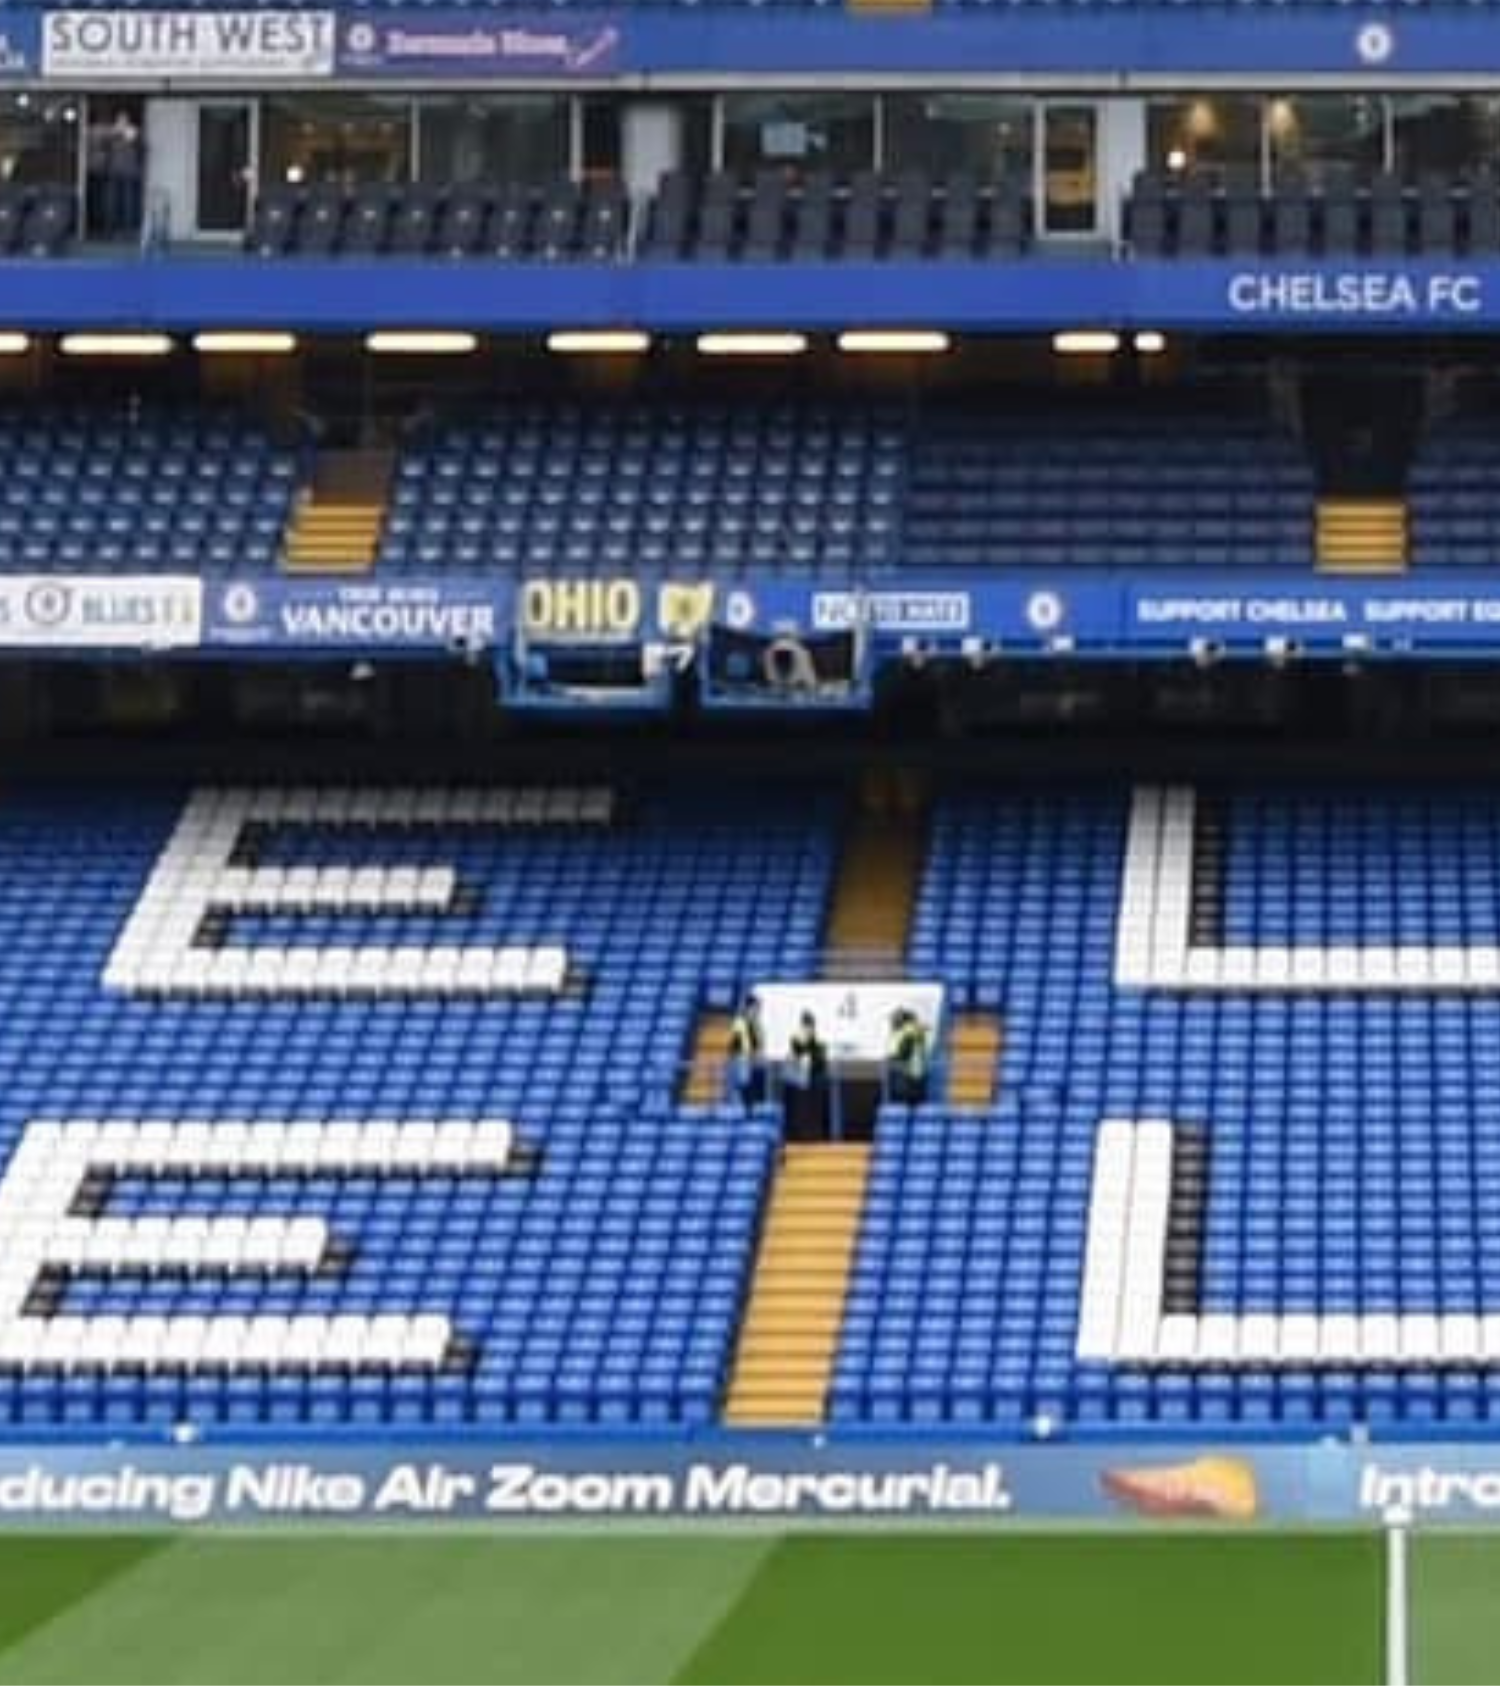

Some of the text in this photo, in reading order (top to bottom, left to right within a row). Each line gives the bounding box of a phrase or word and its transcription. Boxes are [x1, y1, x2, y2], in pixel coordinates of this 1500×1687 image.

[51, 15, 325, 53] SOUTH WEST
[1226, 272, 1482, 312] CHELSEA FC
[281, 604, 495, 636] VANCOUVER
[523, 578, 639, 632] OHIO
[1137, 598, 1348, 623] SUPPORT CHELSEA
[1364, 598, 1466, 623] SUPPORT
[226, 1464, 365, 1510] Nike
[373, 1464, 477, 1510] Air
[485, 1464, 674, 1510] Zoom
[686, 1462, 1011, 1509] Mercurial.
